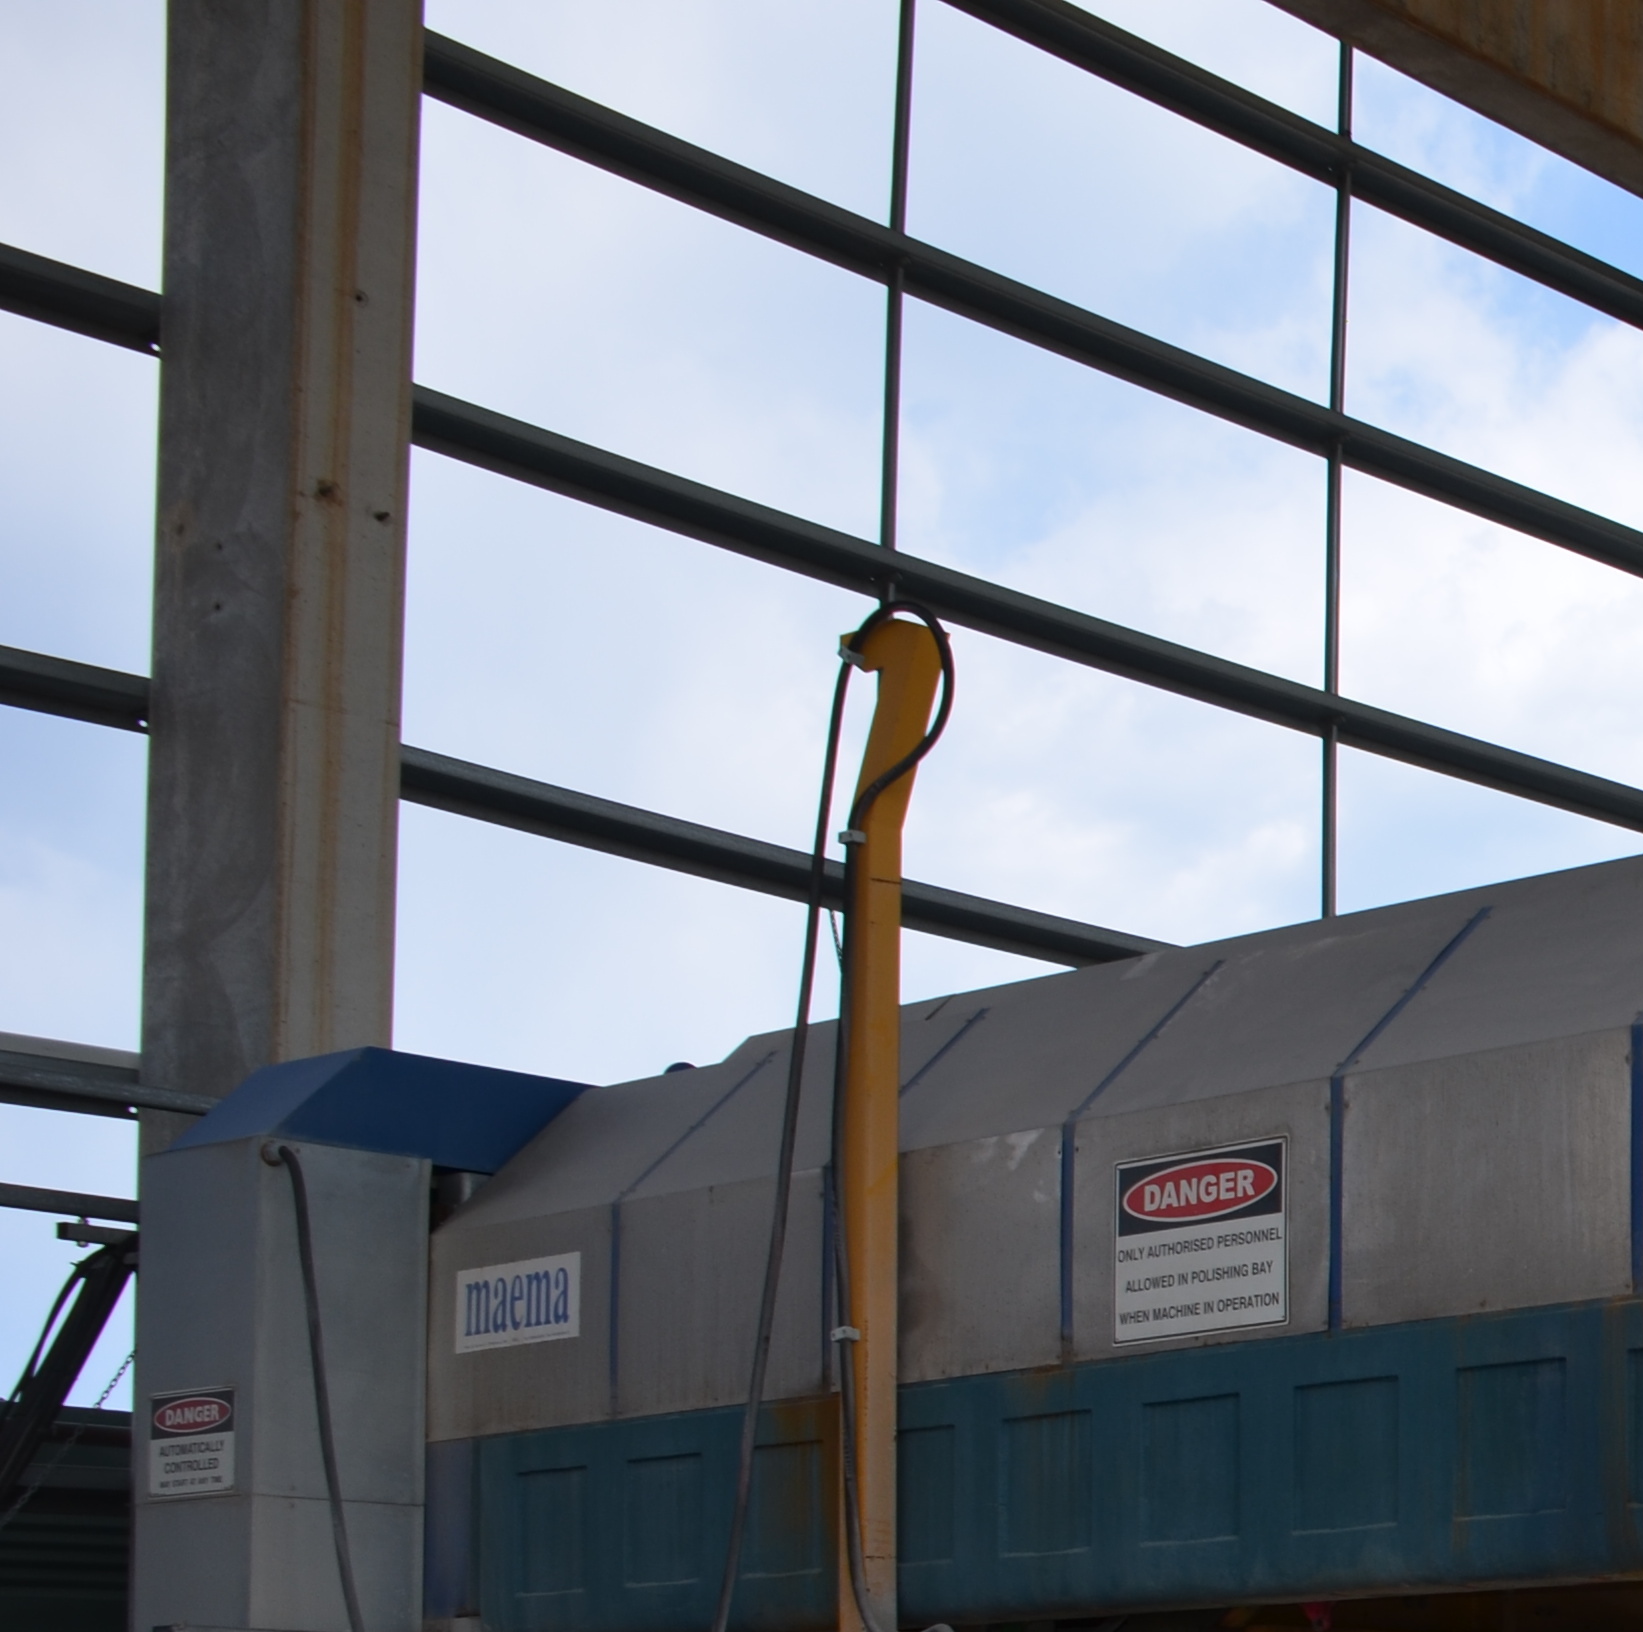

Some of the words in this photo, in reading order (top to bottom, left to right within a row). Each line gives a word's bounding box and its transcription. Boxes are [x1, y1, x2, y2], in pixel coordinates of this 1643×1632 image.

[1143, 1168, 1255, 1212] DANGER
[1118, 1247, 1145, 1263] ONLY
[1147, 1237, 1215, 1259] AUTHORISED
[1217, 1227, 1282, 1249] PERSONNEL
[1125, 1274, 1175, 1293] ALLOWED
[1178, 1272, 1189, 1286] IN
[1191, 1263, 1249, 1285] POLISHING
[1252, 1260, 1273, 1276] BAY
[465, 1267, 570, 1336] maema
[1119, 1310, 1150, 1325] WHEN
[1152, 1302, 1200, 1321] MACHINE
[1203, 1300, 1214, 1314] IN
[1217, 1292, 1280, 1312] OPERATION
[164, 1404, 220, 1426] DANGER
[160, 1440, 225, 1457] AUTOMATICALLY
[164, 1457, 219, 1474] CONTROLLED
